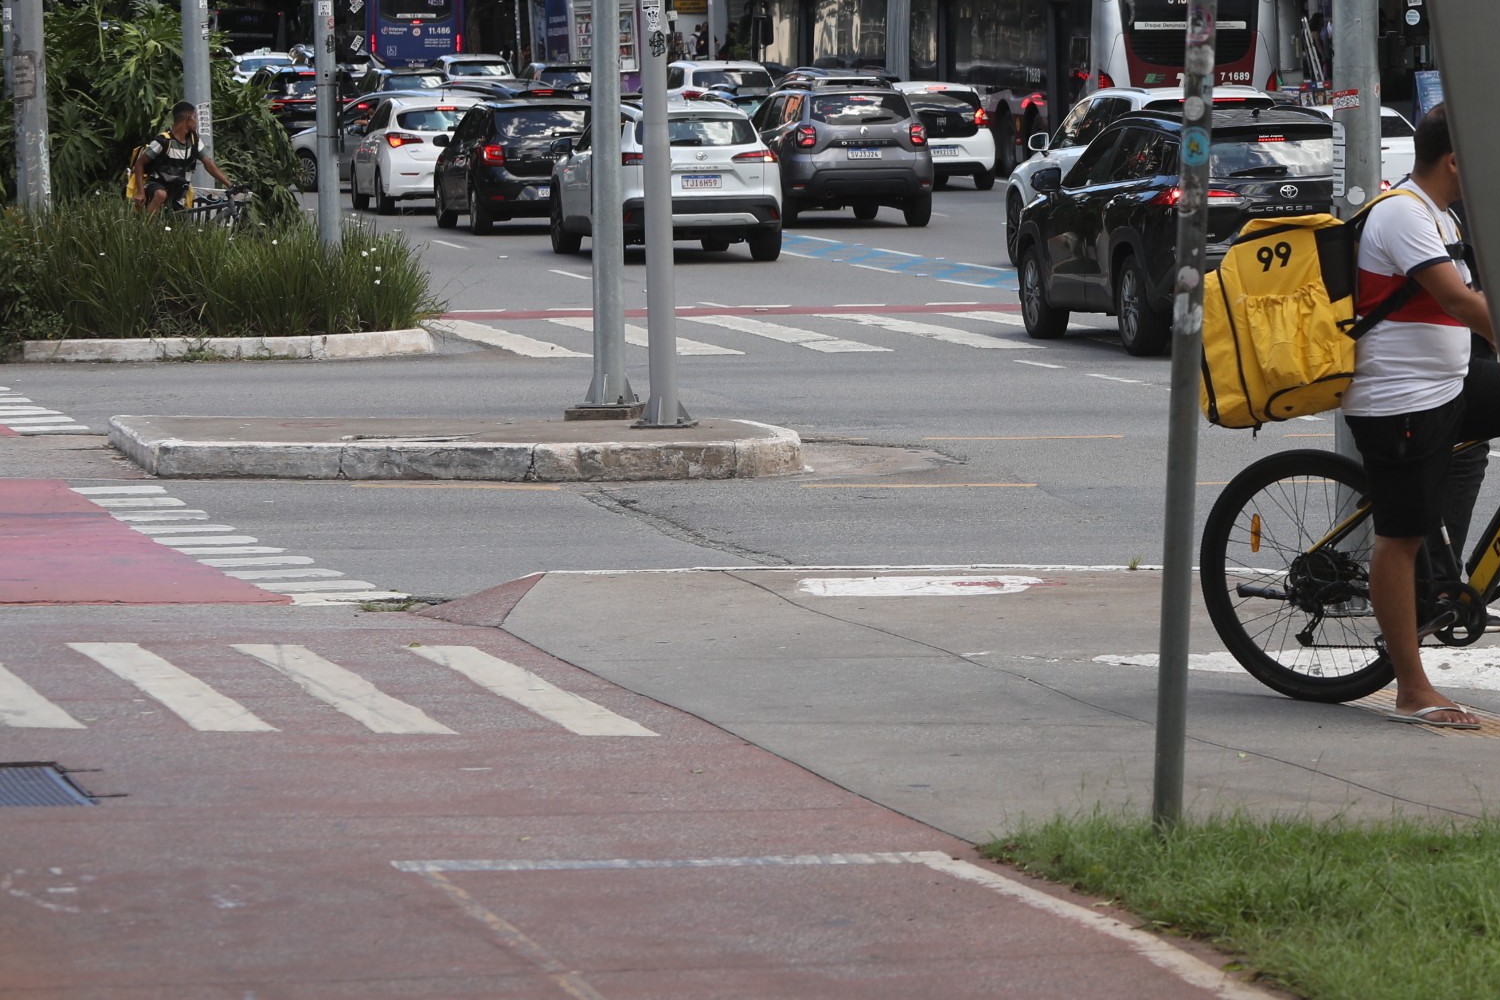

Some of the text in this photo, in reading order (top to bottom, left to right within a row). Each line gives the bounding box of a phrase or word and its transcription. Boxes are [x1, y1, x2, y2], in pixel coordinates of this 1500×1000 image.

[428, 27, 451, 35] 11.486
[1229, 72, 1250, 81] 1689
[936, 117, 947, 126] FIAT
[1266, 204, 1313, 212] CROSS
[1256, 241, 1292, 272] 99
